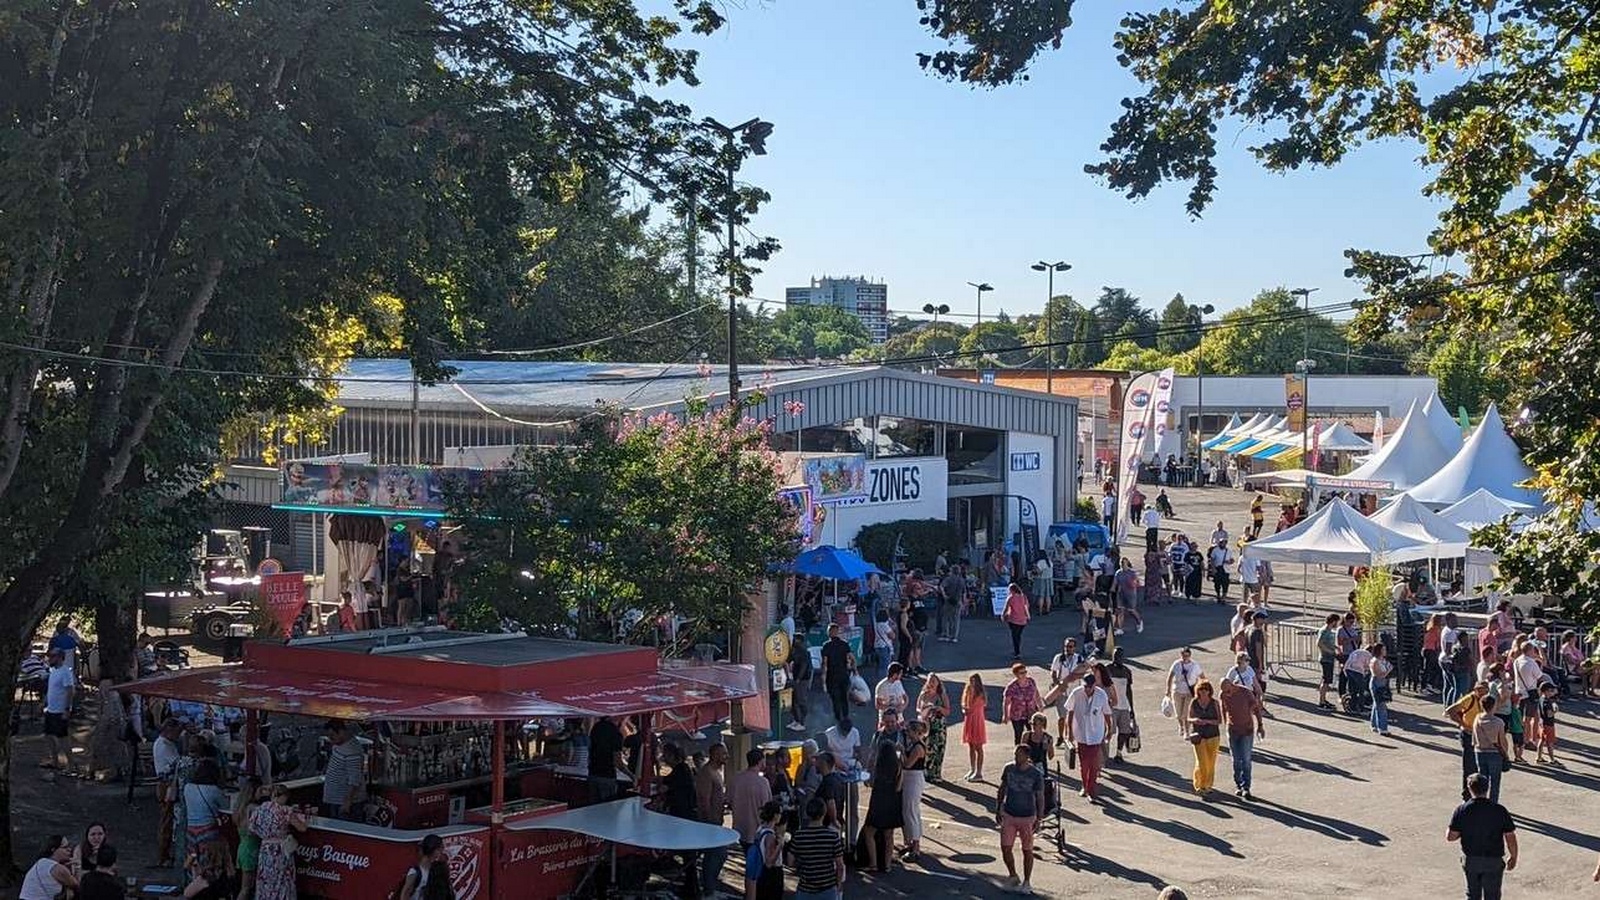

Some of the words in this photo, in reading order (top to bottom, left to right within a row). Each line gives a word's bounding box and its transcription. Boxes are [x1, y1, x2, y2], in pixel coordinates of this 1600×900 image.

[1025, 454, 1039, 469] WC
[869, 466, 920, 502] ZONES
[266, 581, 299, 593] BELLE
[296, 844, 319, 862] ays
[322, 844, 370, 870] Basque
[510, 847, 524, 862] La
[526, 838, 569, 859] Brasserie
[569, 837, 583, 849] du
